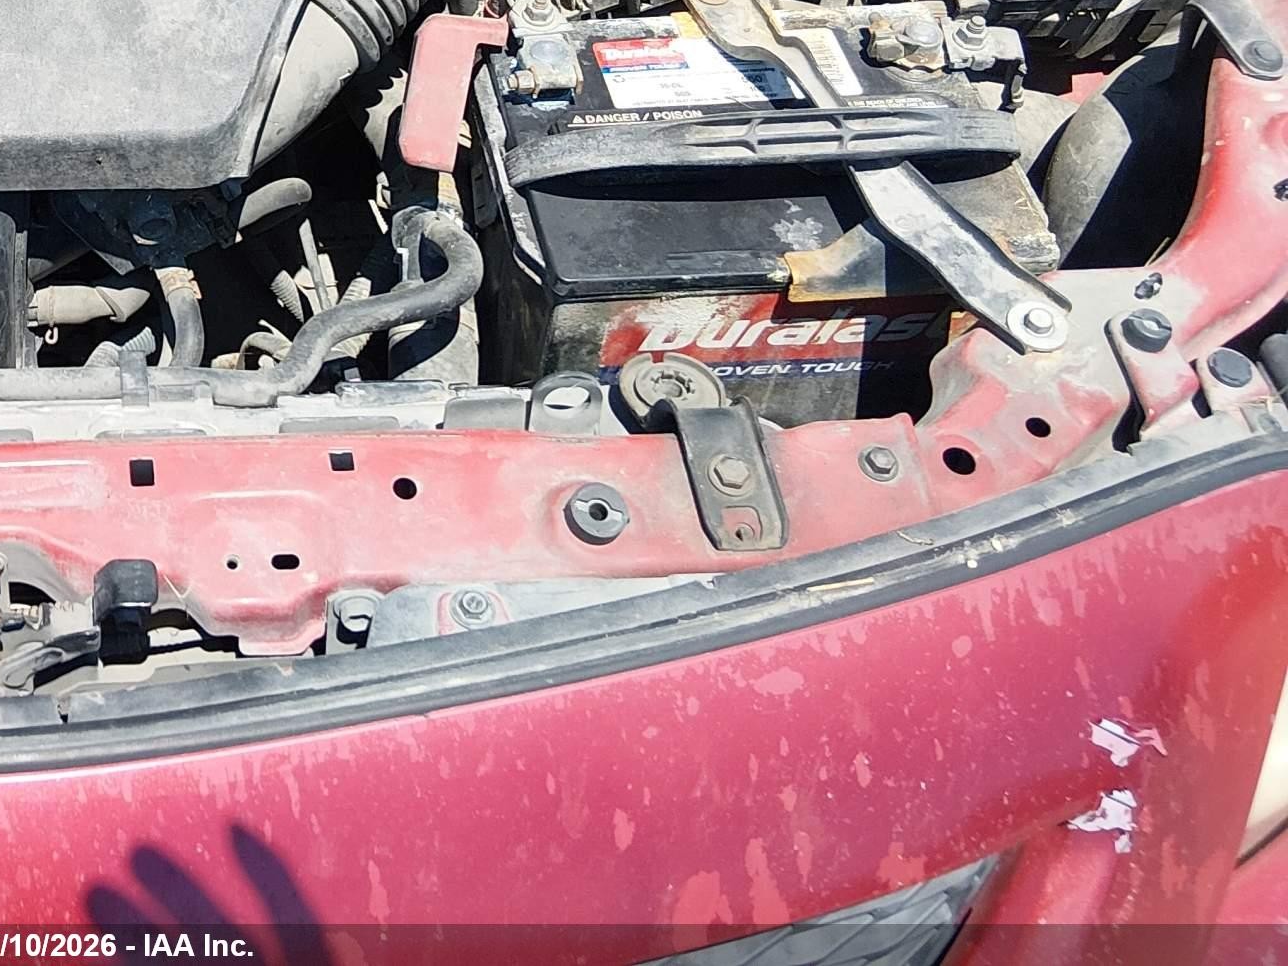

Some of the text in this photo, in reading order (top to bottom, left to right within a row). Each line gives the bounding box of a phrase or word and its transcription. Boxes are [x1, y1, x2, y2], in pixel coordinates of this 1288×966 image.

[585, 110, 704, 124] DANGER / POISON
[710, 360, 893, 376] OVEN TOUGH
